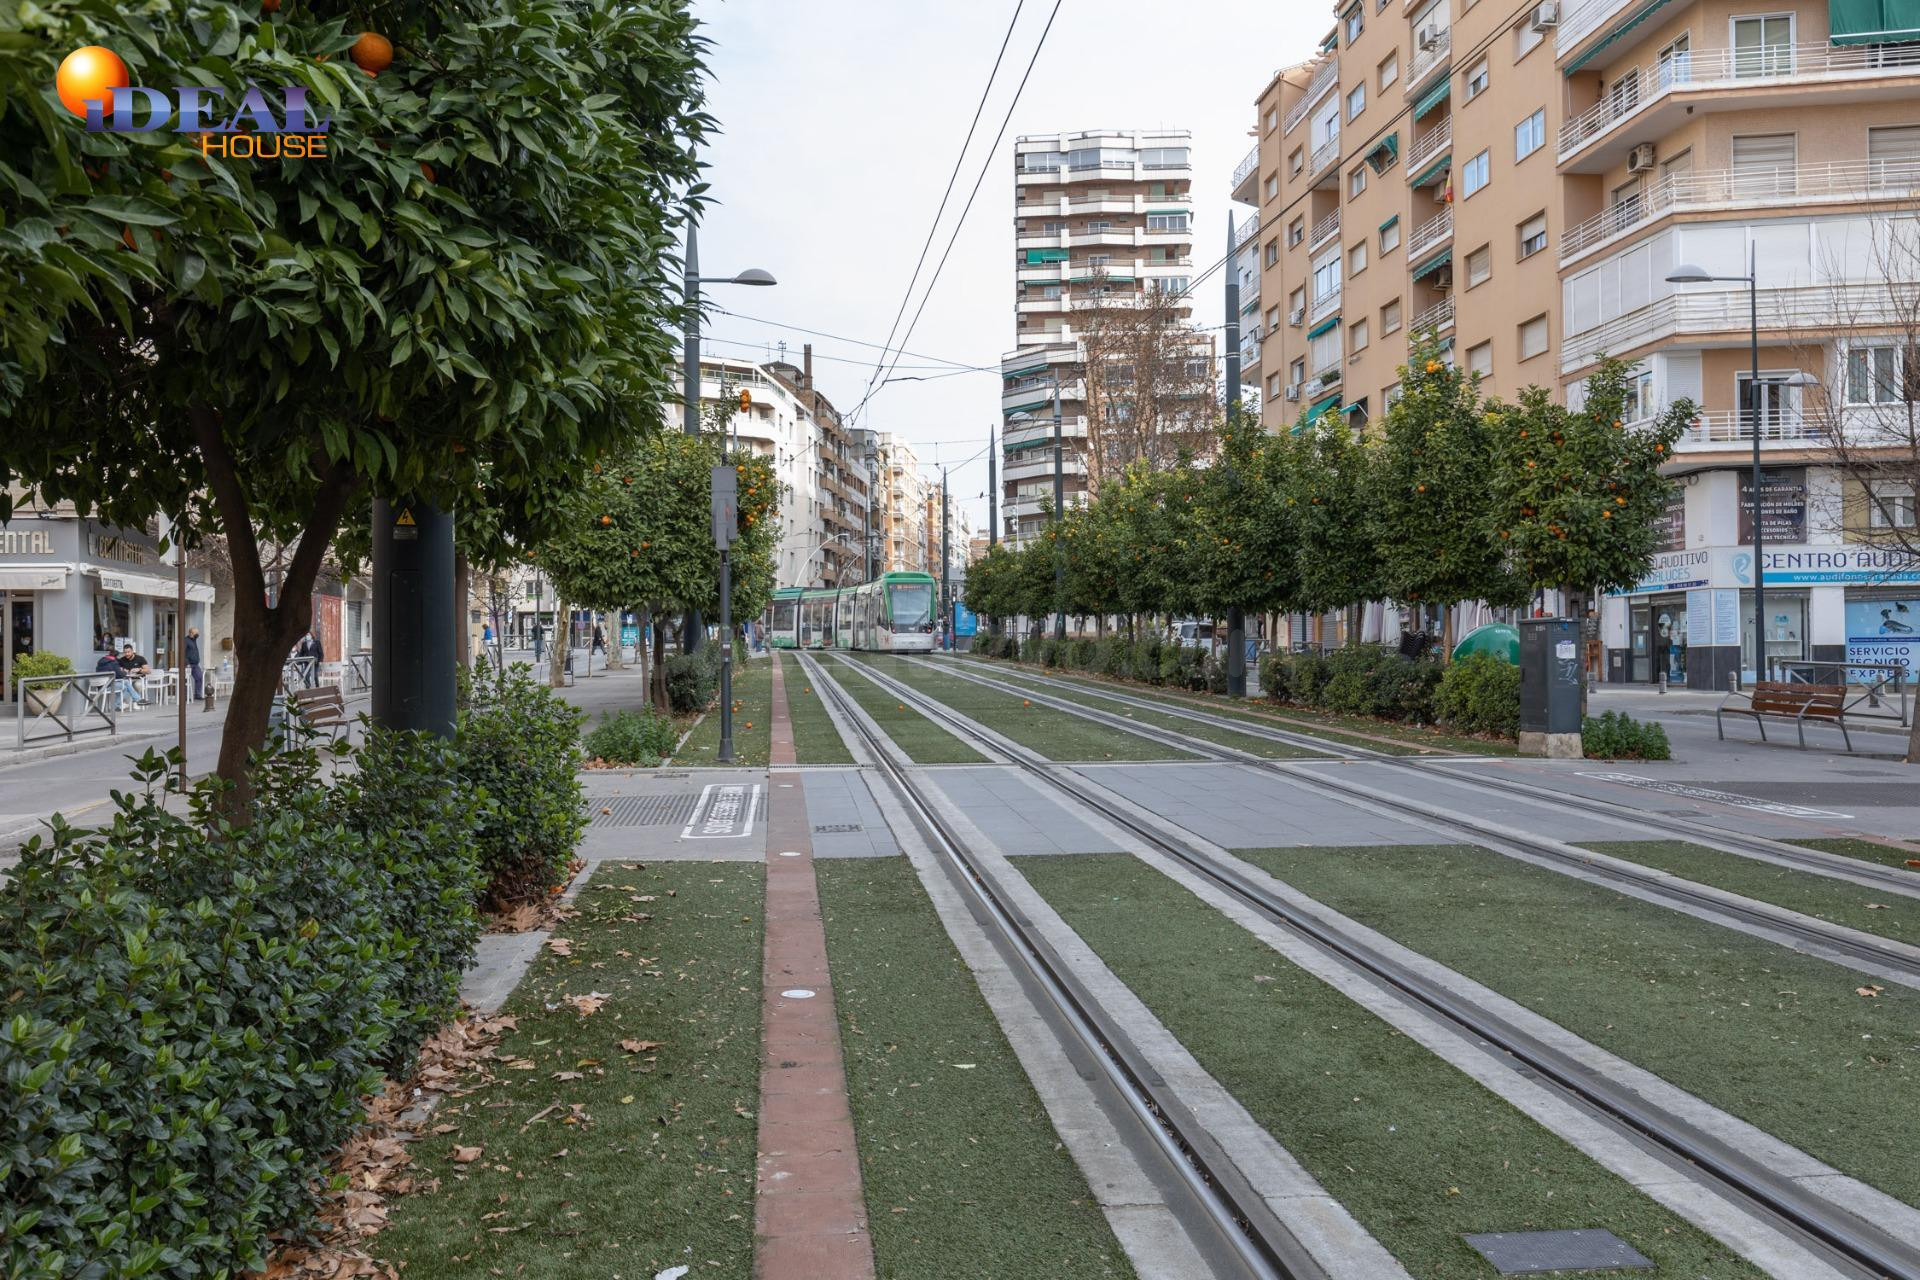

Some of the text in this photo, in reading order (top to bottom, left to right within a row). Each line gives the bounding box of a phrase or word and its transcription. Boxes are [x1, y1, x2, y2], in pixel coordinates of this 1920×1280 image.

[1661, 551, 1708, 569] AUDITIVO
[1761, 552, 1847, 569] CENTRO
[1648, 567, 1691, 584] DALUCES
[1849, 647, 1910, 656] SERVICIO
[1850, 669, 1910, 678] EXPES
